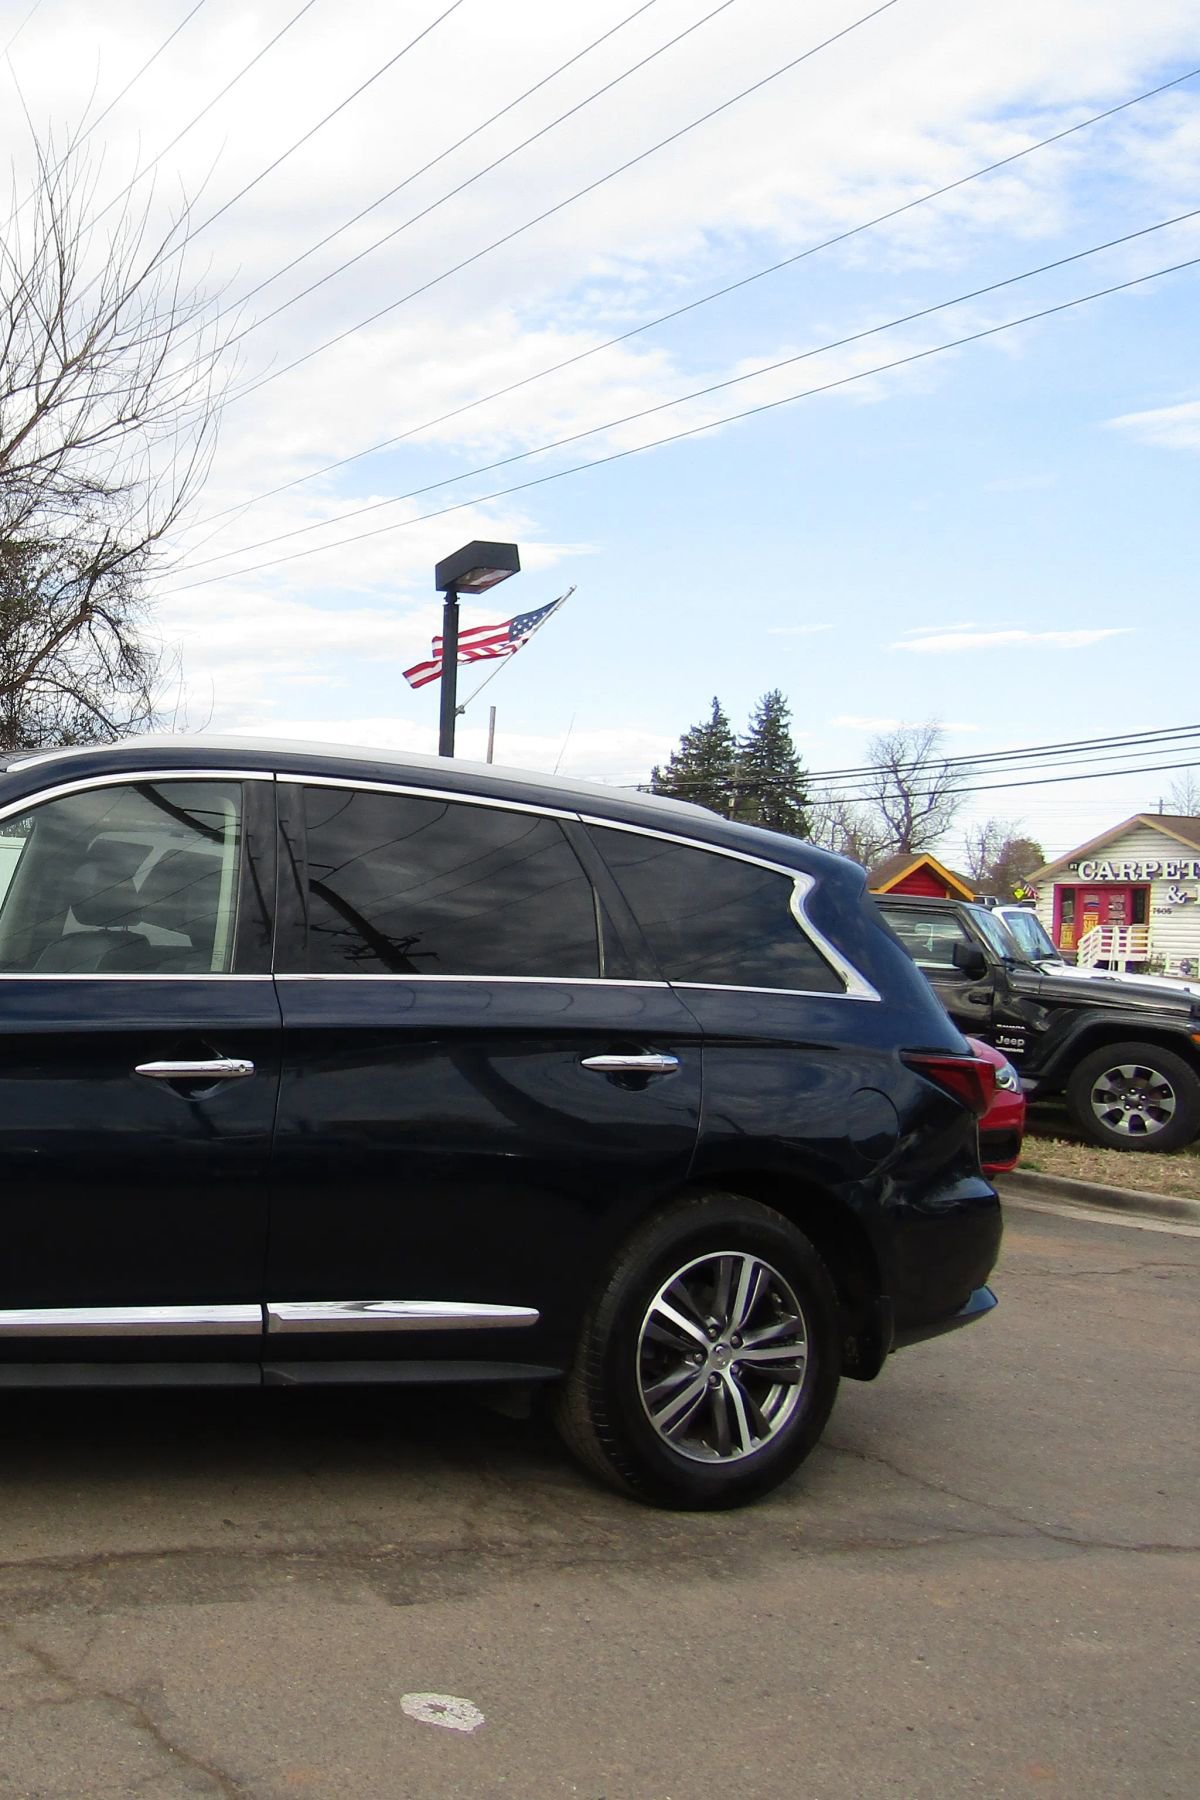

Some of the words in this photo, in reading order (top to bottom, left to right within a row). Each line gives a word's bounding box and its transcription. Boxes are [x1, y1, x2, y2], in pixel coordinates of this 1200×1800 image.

[1078, 861, 1200, 880] CARPET
[1167, 885, 1187, 904] &
[995, 1035, 1026, 1048] Jeep
